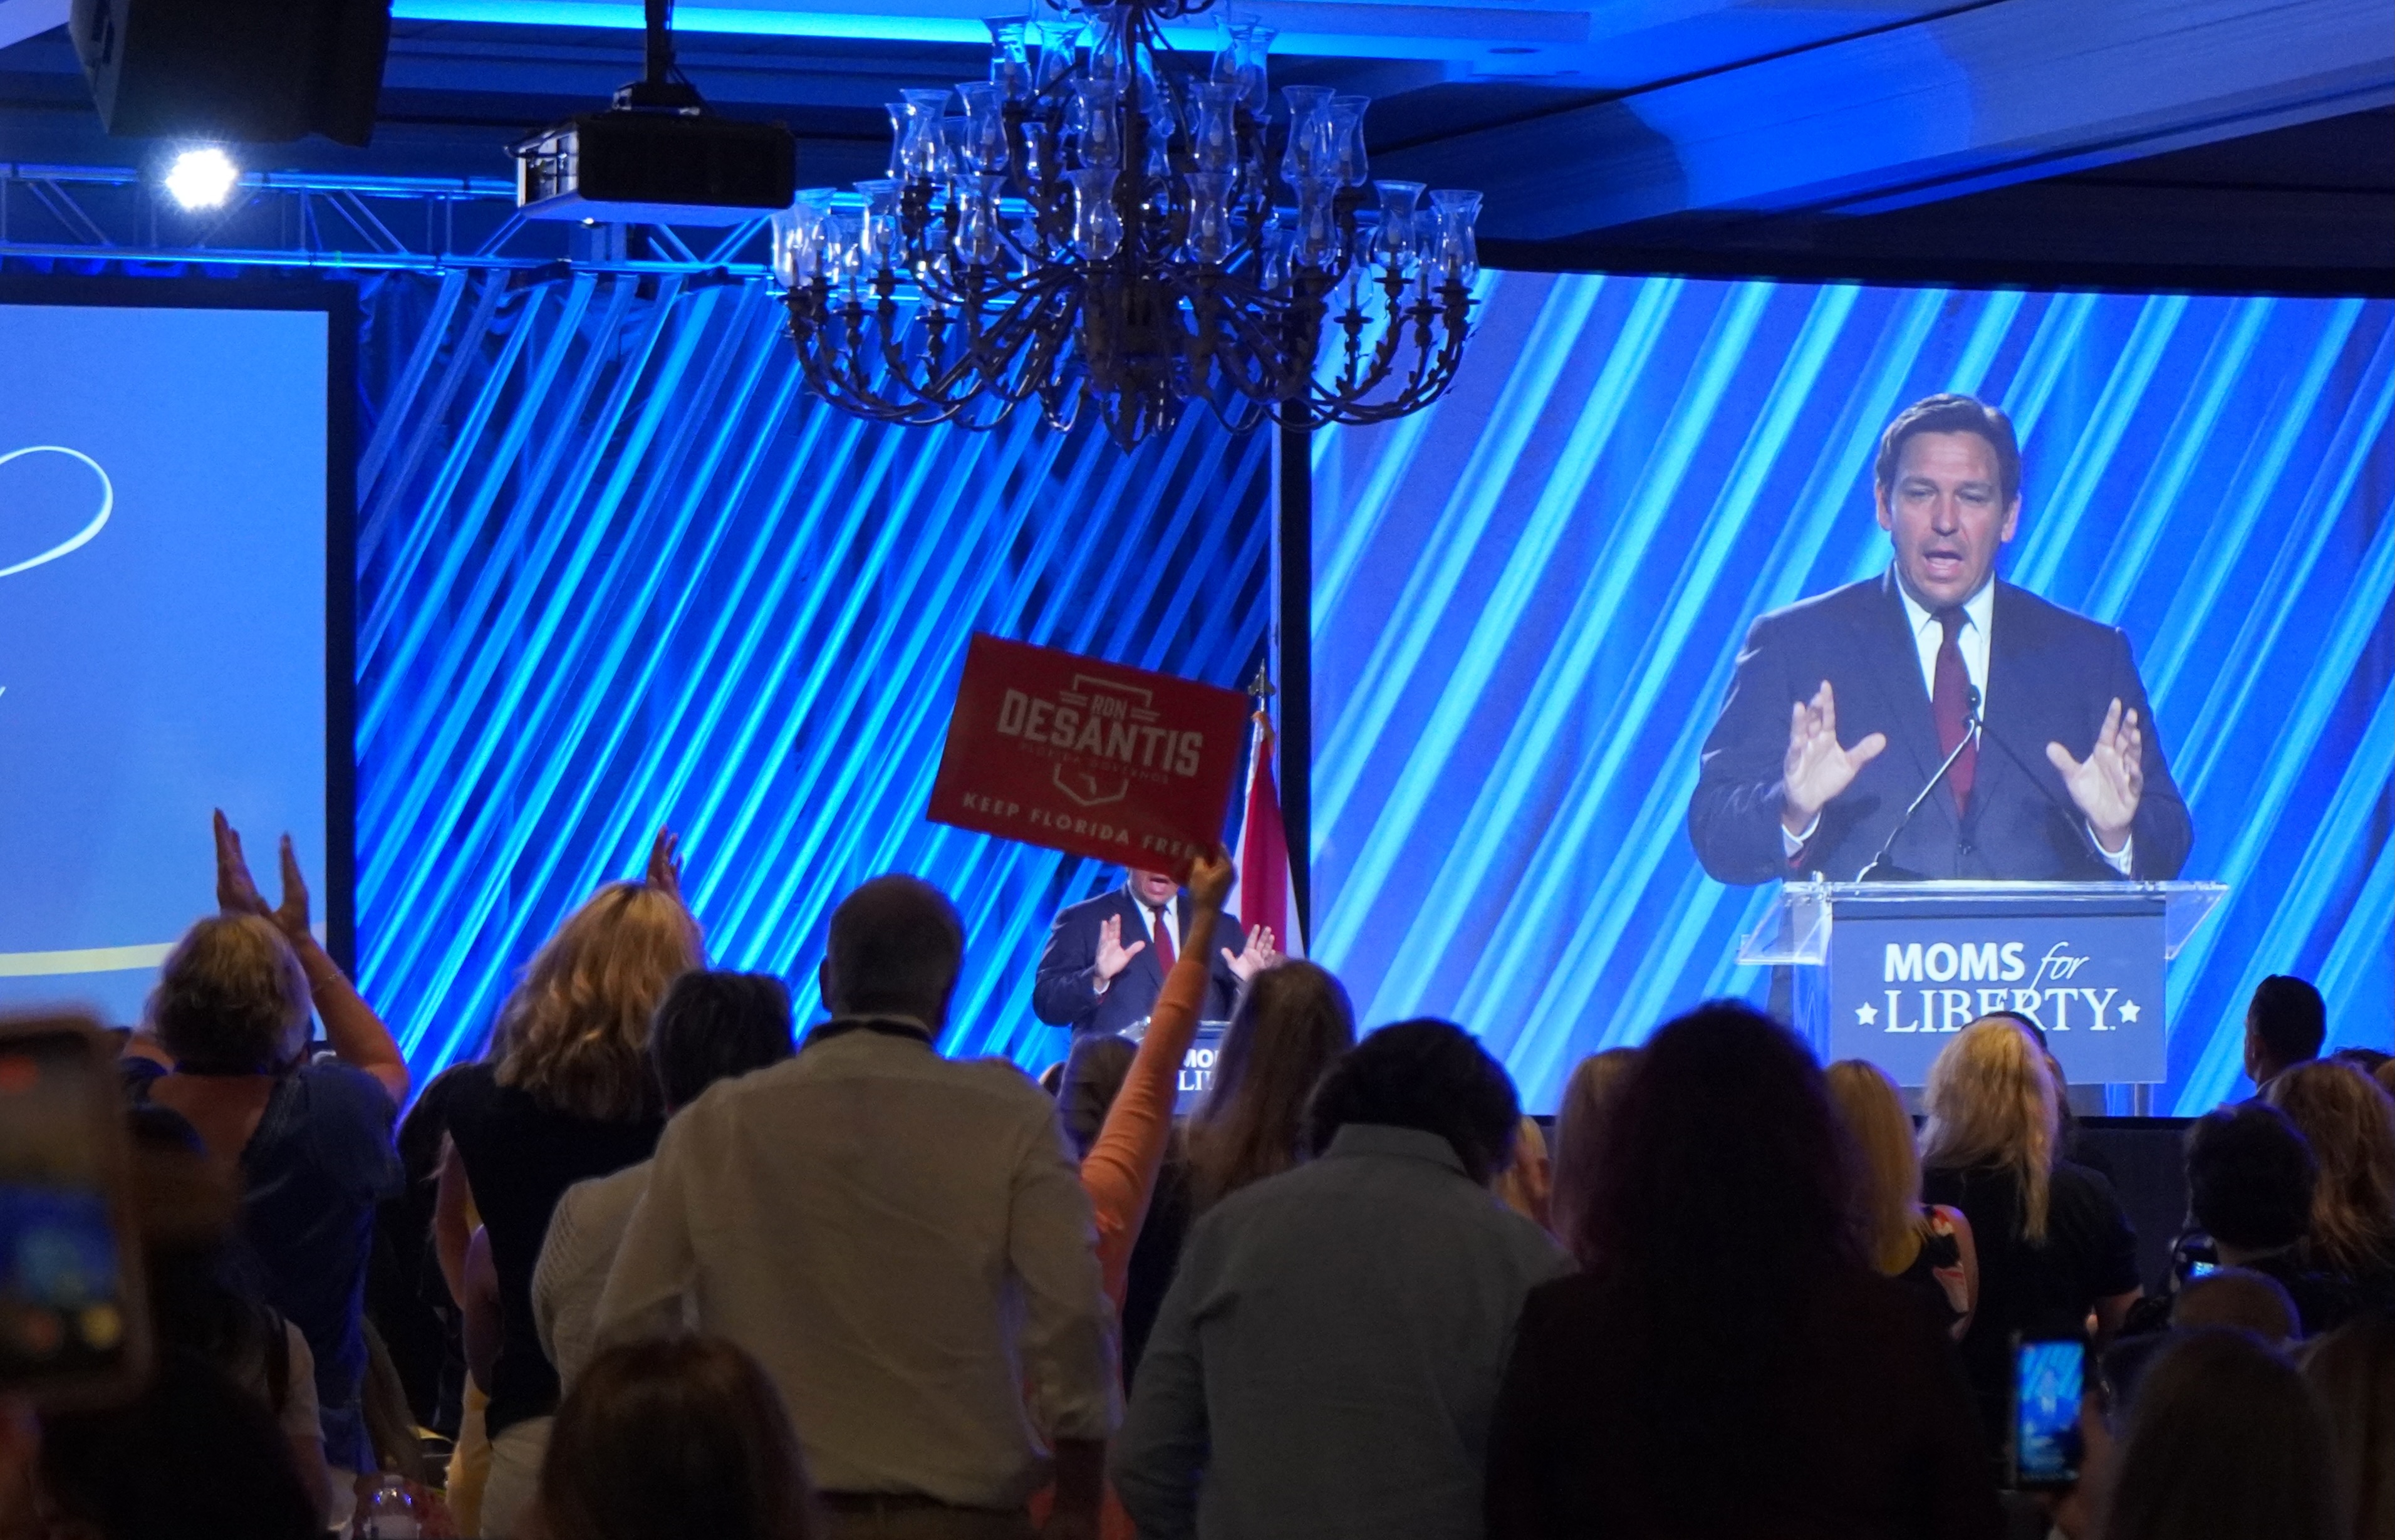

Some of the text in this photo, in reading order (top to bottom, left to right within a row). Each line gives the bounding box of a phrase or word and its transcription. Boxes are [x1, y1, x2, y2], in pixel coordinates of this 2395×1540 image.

[997, 688, 1203, 778] DESANTIS
[1091, 694, 1128, 720] RON
[962, 792, 1021, 818] KEEP
[1030, 808, 1130, 845] FLORIDA
[1884, 941, 2090, 1001] MOMS for
[1183, 1048, 1219, 1068] MO
